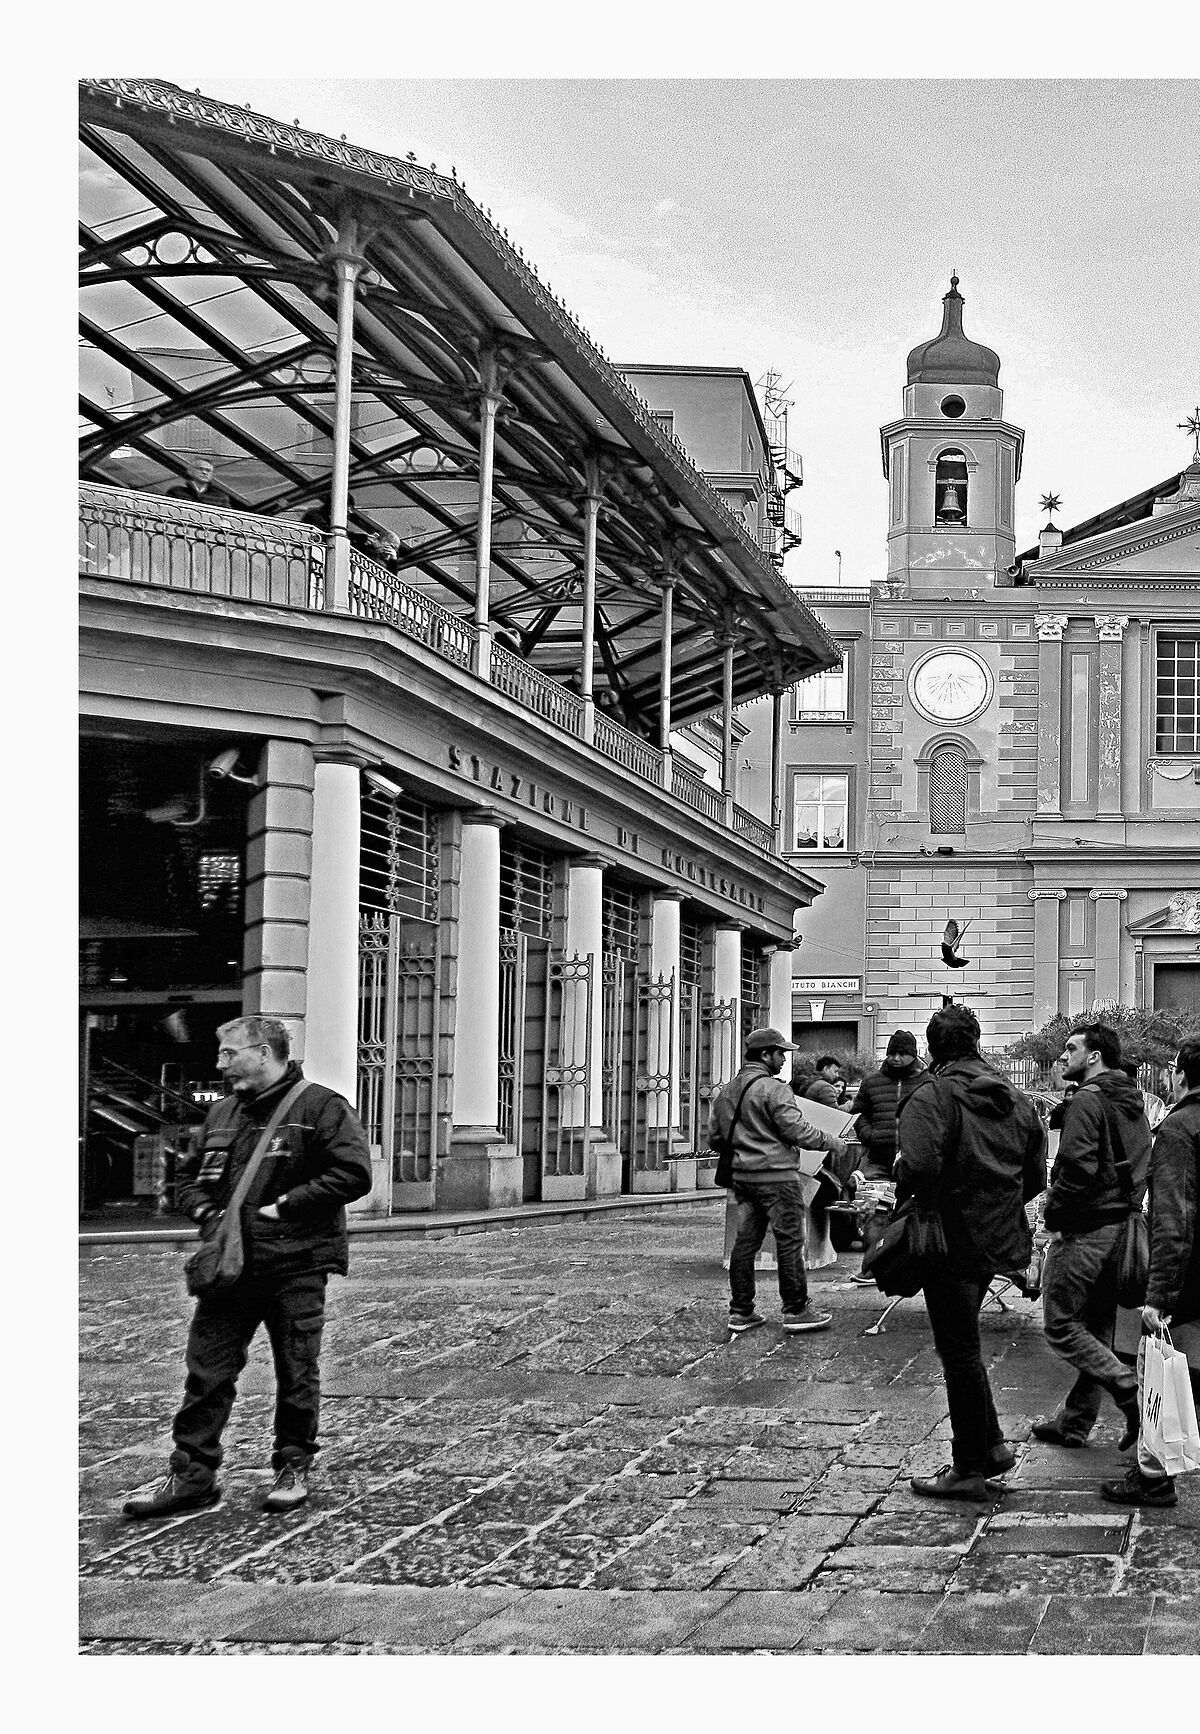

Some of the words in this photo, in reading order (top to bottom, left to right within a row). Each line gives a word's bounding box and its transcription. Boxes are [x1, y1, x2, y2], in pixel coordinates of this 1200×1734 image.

[449, 745, 590, 831] STAZIONE
[617, 826, 640, 854] DI
[662, 849, 766, 913] MONTESANTO
[821, 981, 856, 989] BIANCHI
